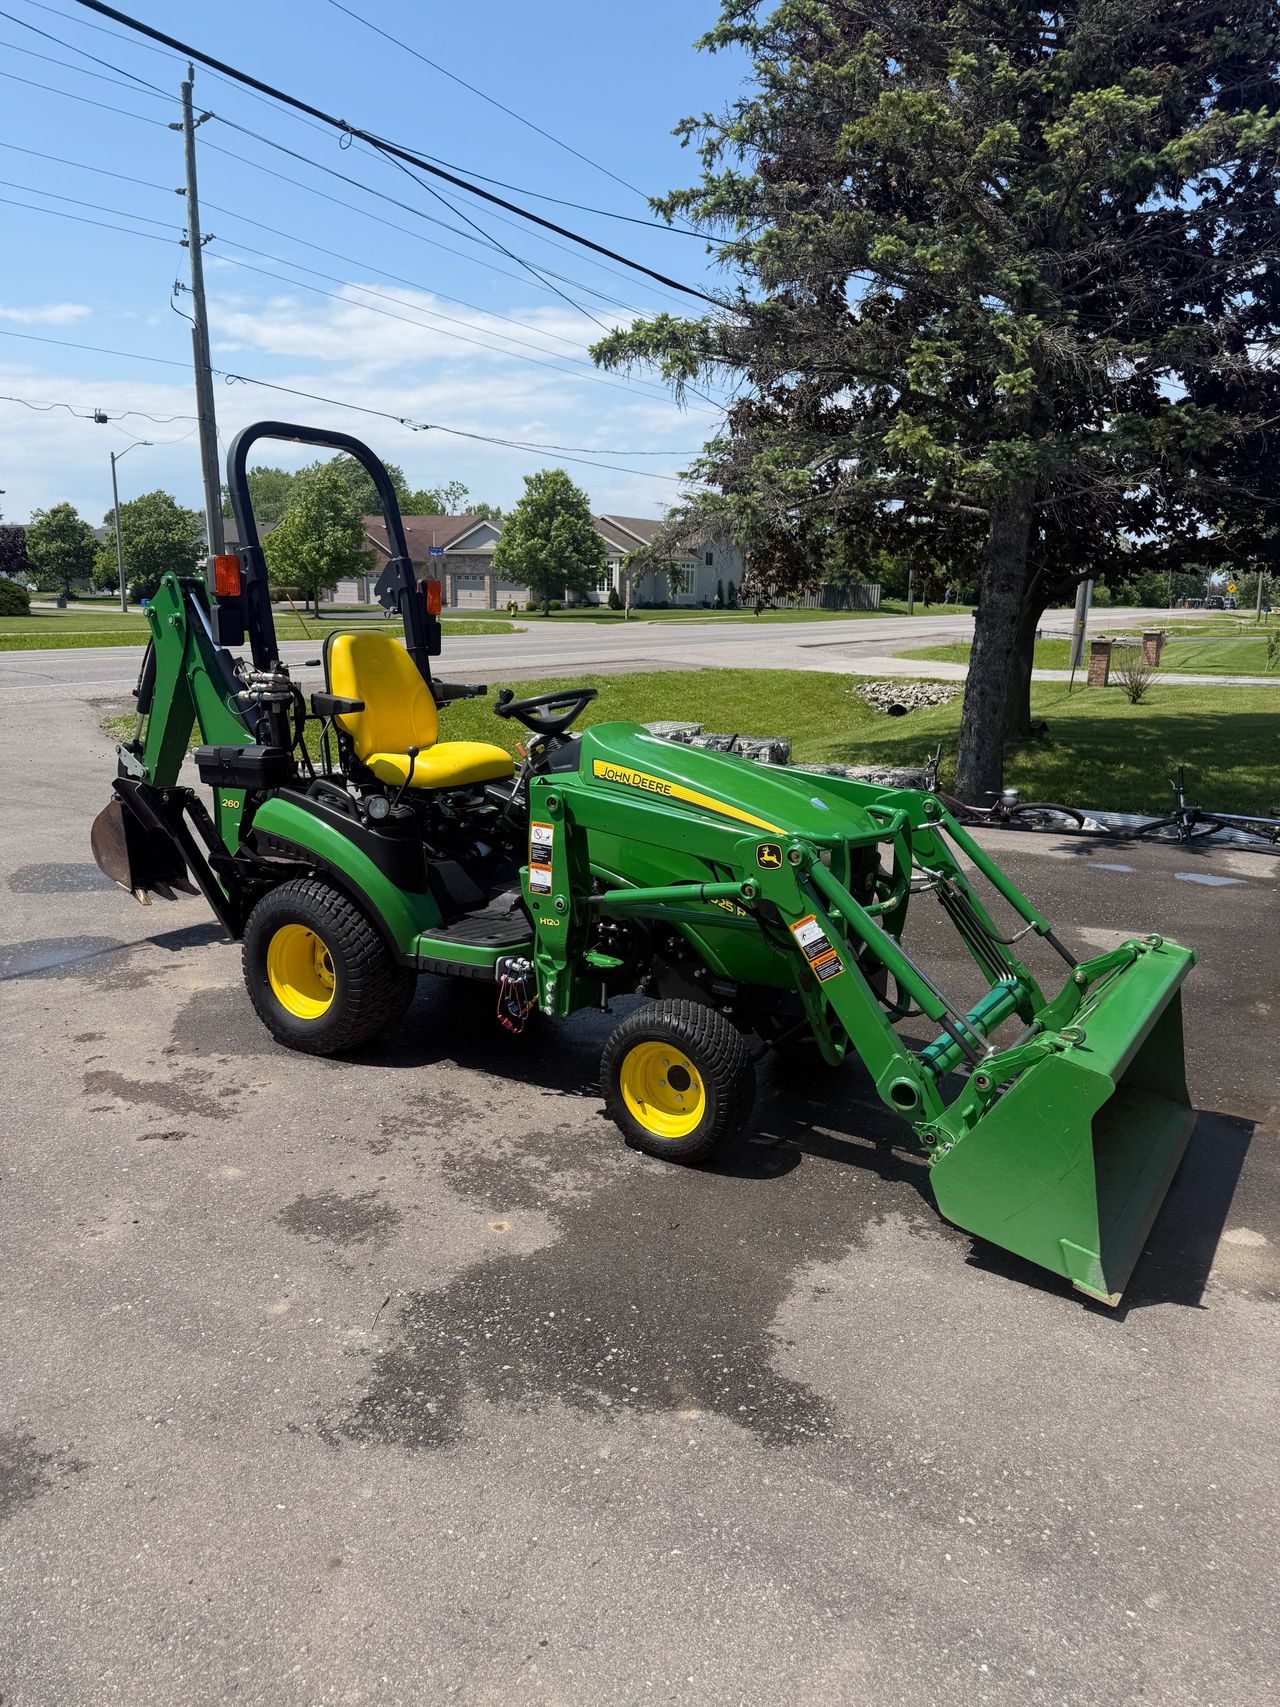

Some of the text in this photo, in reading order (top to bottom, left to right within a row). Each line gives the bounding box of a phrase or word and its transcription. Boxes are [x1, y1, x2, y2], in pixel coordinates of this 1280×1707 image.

[601, 766, 672, 795] JOHN DEERE
[222, 798, 240, 808] 260
[539, 917, 560, 926] H120
